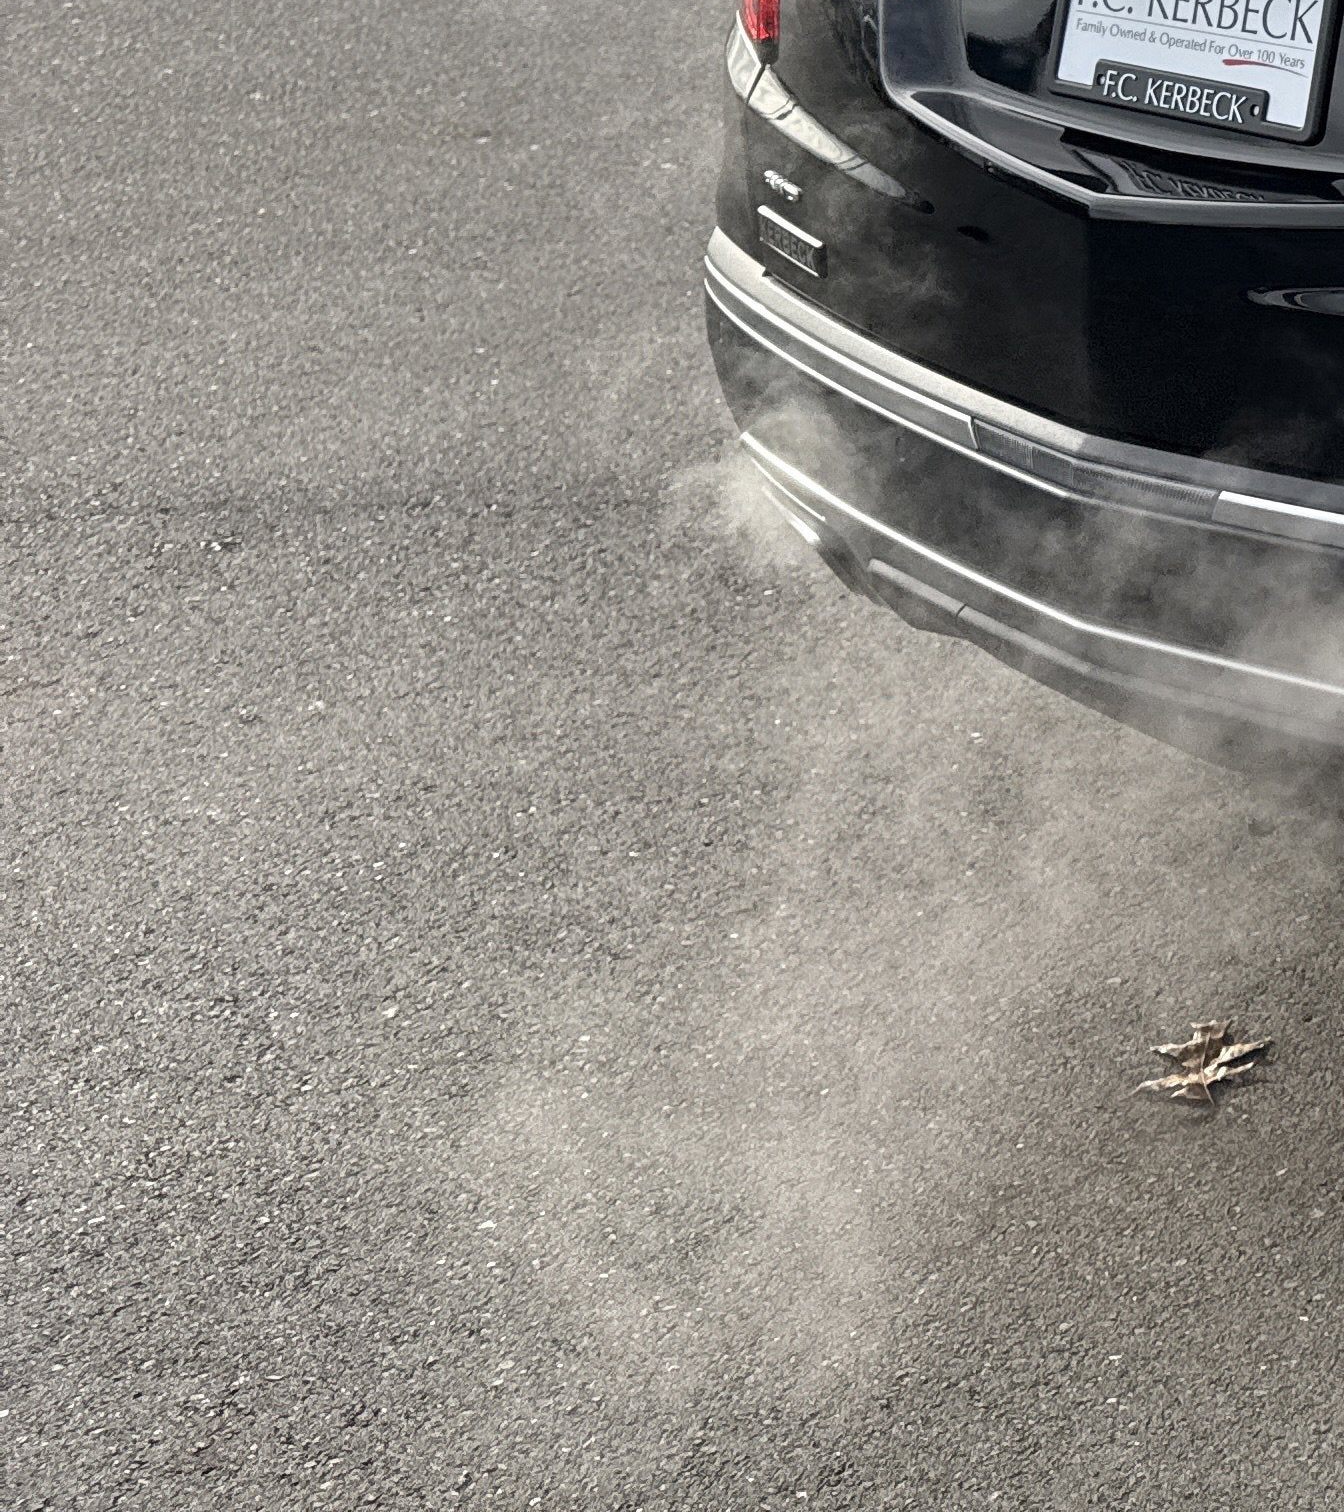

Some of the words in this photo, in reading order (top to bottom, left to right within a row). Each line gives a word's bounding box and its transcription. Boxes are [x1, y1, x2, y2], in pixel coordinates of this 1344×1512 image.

[1076, 18, 1107, 37] Family
[1109, 23, 1147, 42] Owned
[1149, 31, 1157, 43] &
[1160, 32, 1207, 52] Operated
[1208, 39, 1226, 55] For
[1228, 44, 1254, 59] Over
[1257, 49, 1276, 64] 100
[1280, 52, 1305, 69] Years
[1103, 70, 1138, 102] F.C.
[1144, 78, 1247, 124] KERBECK
